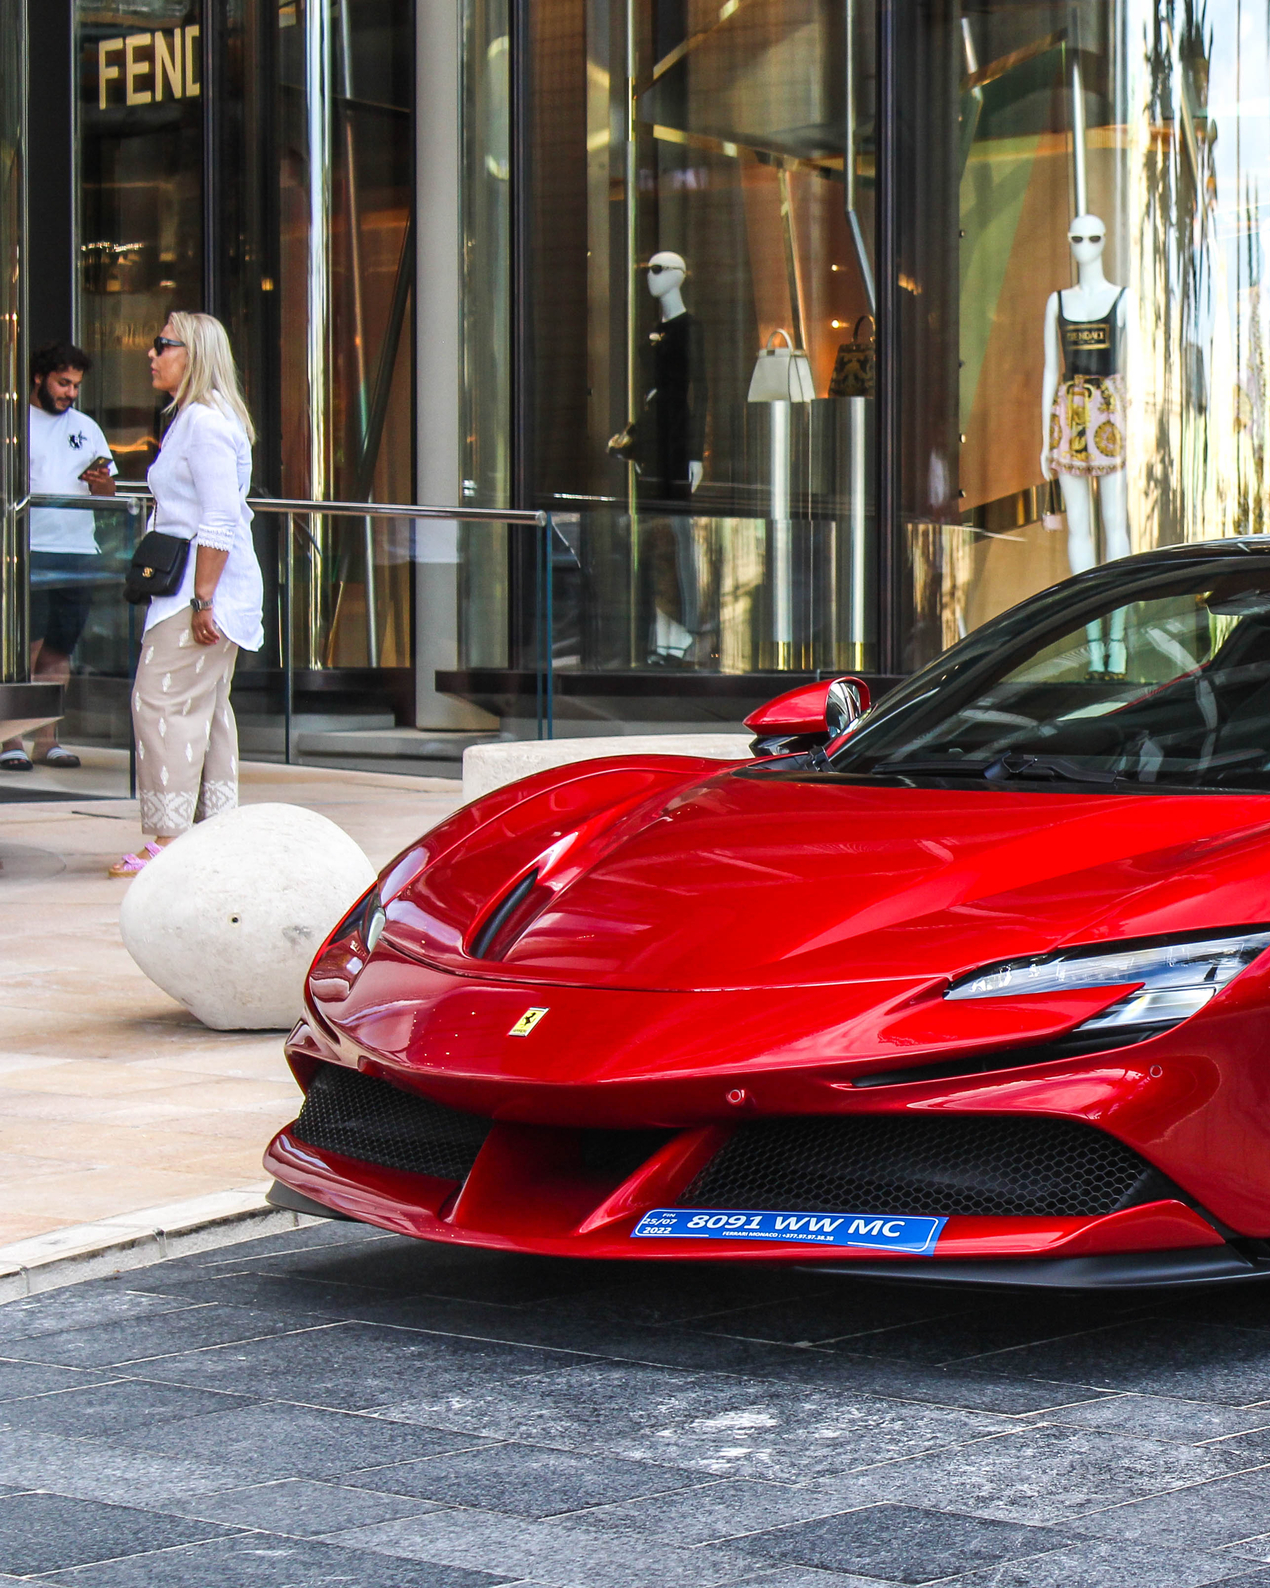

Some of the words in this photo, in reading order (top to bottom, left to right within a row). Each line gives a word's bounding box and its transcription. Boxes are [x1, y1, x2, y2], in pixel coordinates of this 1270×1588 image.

[687, 1215, 763, 1230] 8091
[774, 1216, 845, 1232] WW
[847, 1219, 906, 1237] MC
